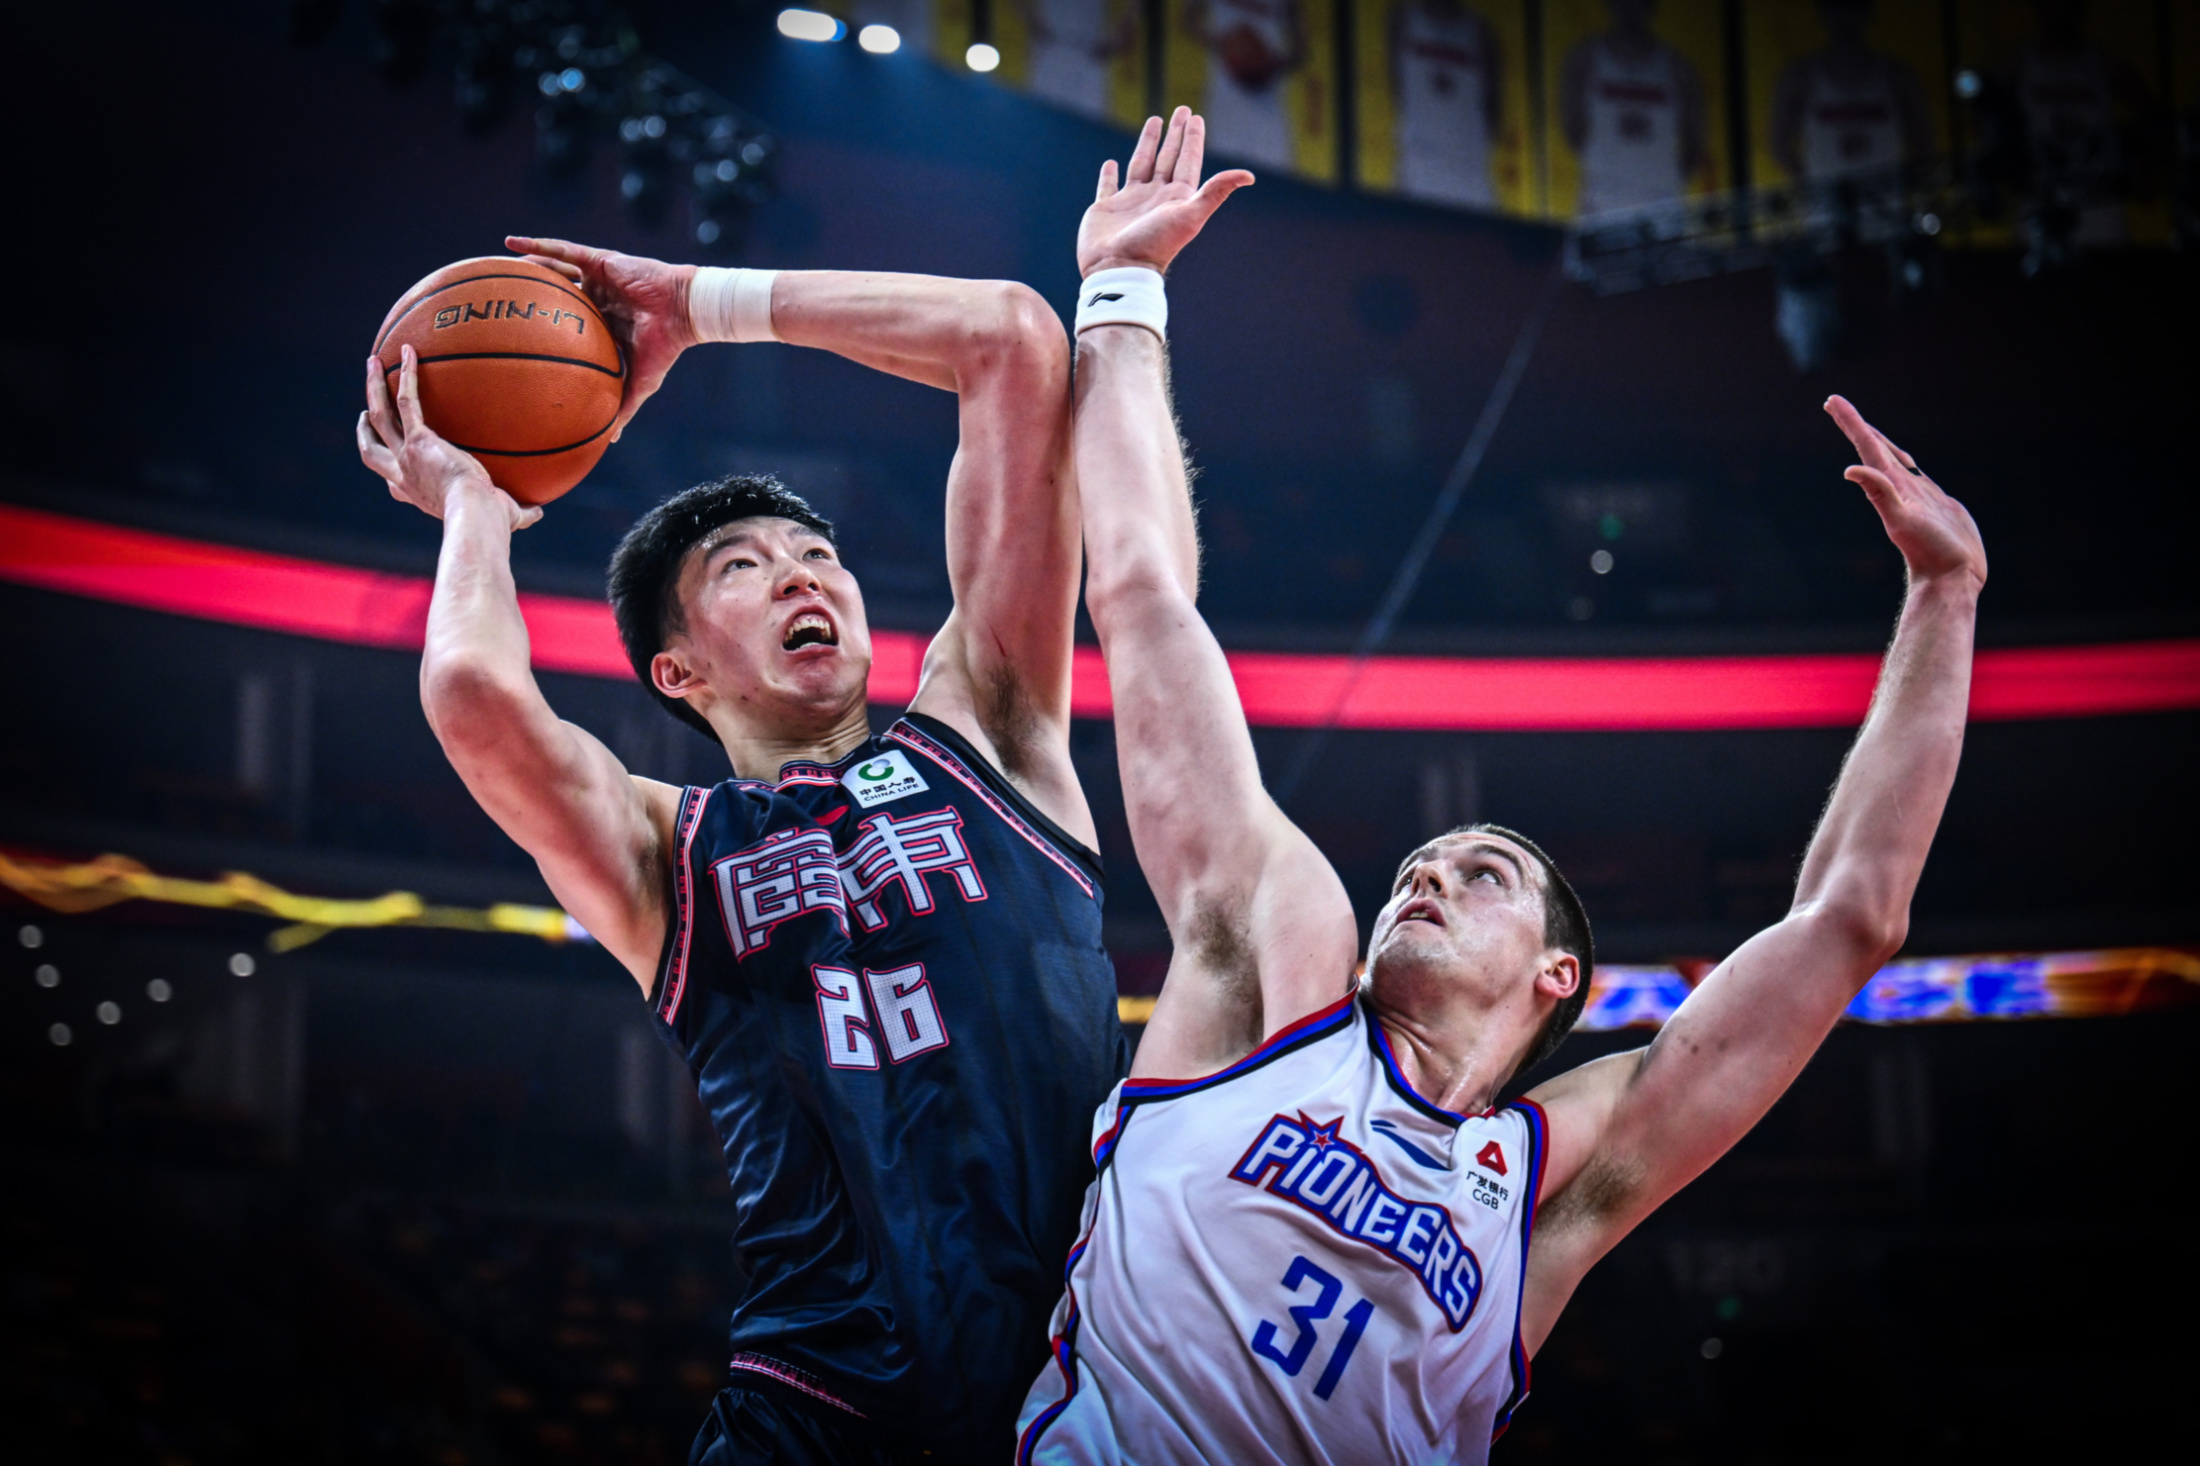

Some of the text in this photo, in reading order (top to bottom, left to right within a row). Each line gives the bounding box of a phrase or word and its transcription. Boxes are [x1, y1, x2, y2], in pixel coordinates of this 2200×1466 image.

[434, 300, 585, 334] LI-NING
[859, 776, 916, 796] 中国人寿
[864, 783, 920, 802] CHINA LIFE
[811, 962, 949, 1071] 26
[1466, 1170, 1509, 1202] 广发银行
[1472, 1188, 1499, 1210] CGB
[1252, 1255, 1375, 1401] 31
